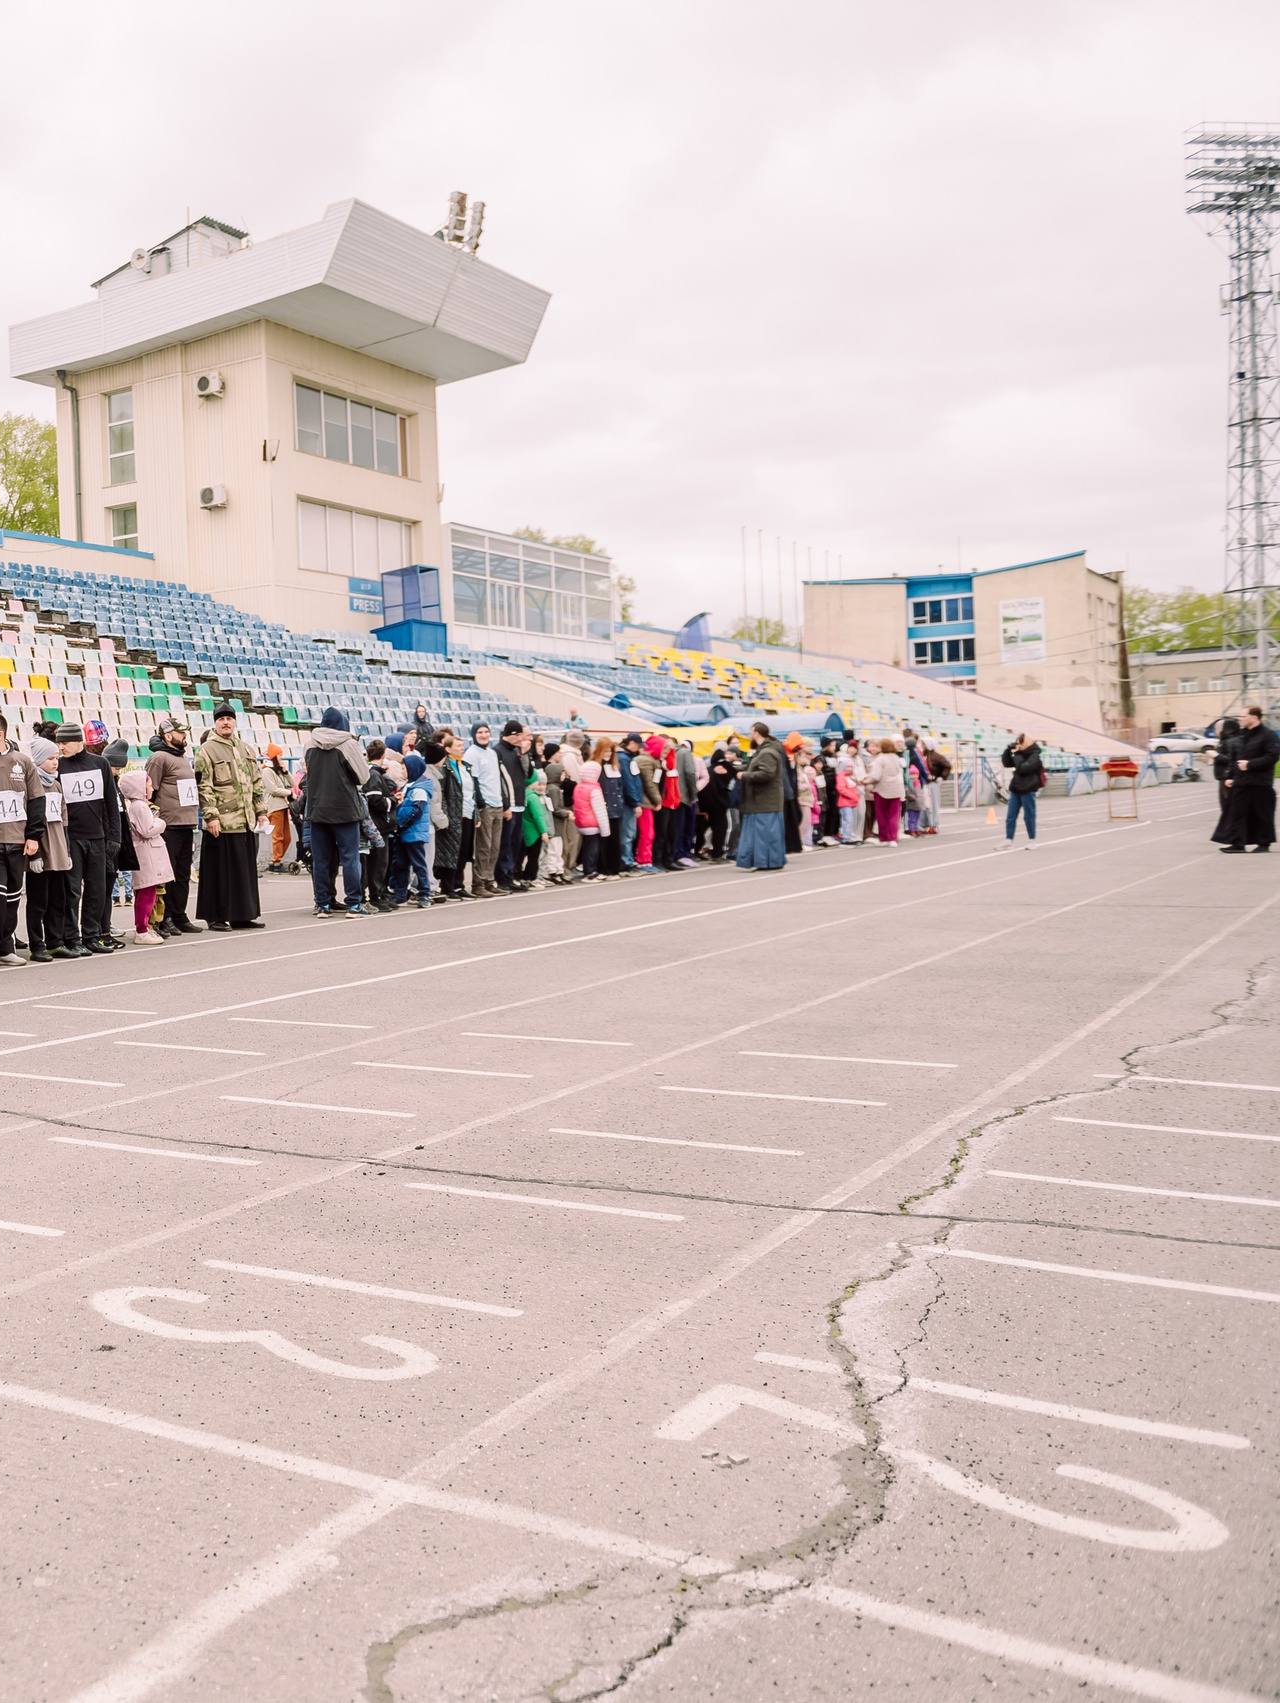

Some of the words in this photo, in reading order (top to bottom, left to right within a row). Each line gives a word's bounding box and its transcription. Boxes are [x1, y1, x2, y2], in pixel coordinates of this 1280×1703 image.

[352, 598, 380, 613] PRESS
[71, 778, 96, 797] 49
[91, 1286, 440, 1382] 3
[654, 1383, 1230, 1552] 2
